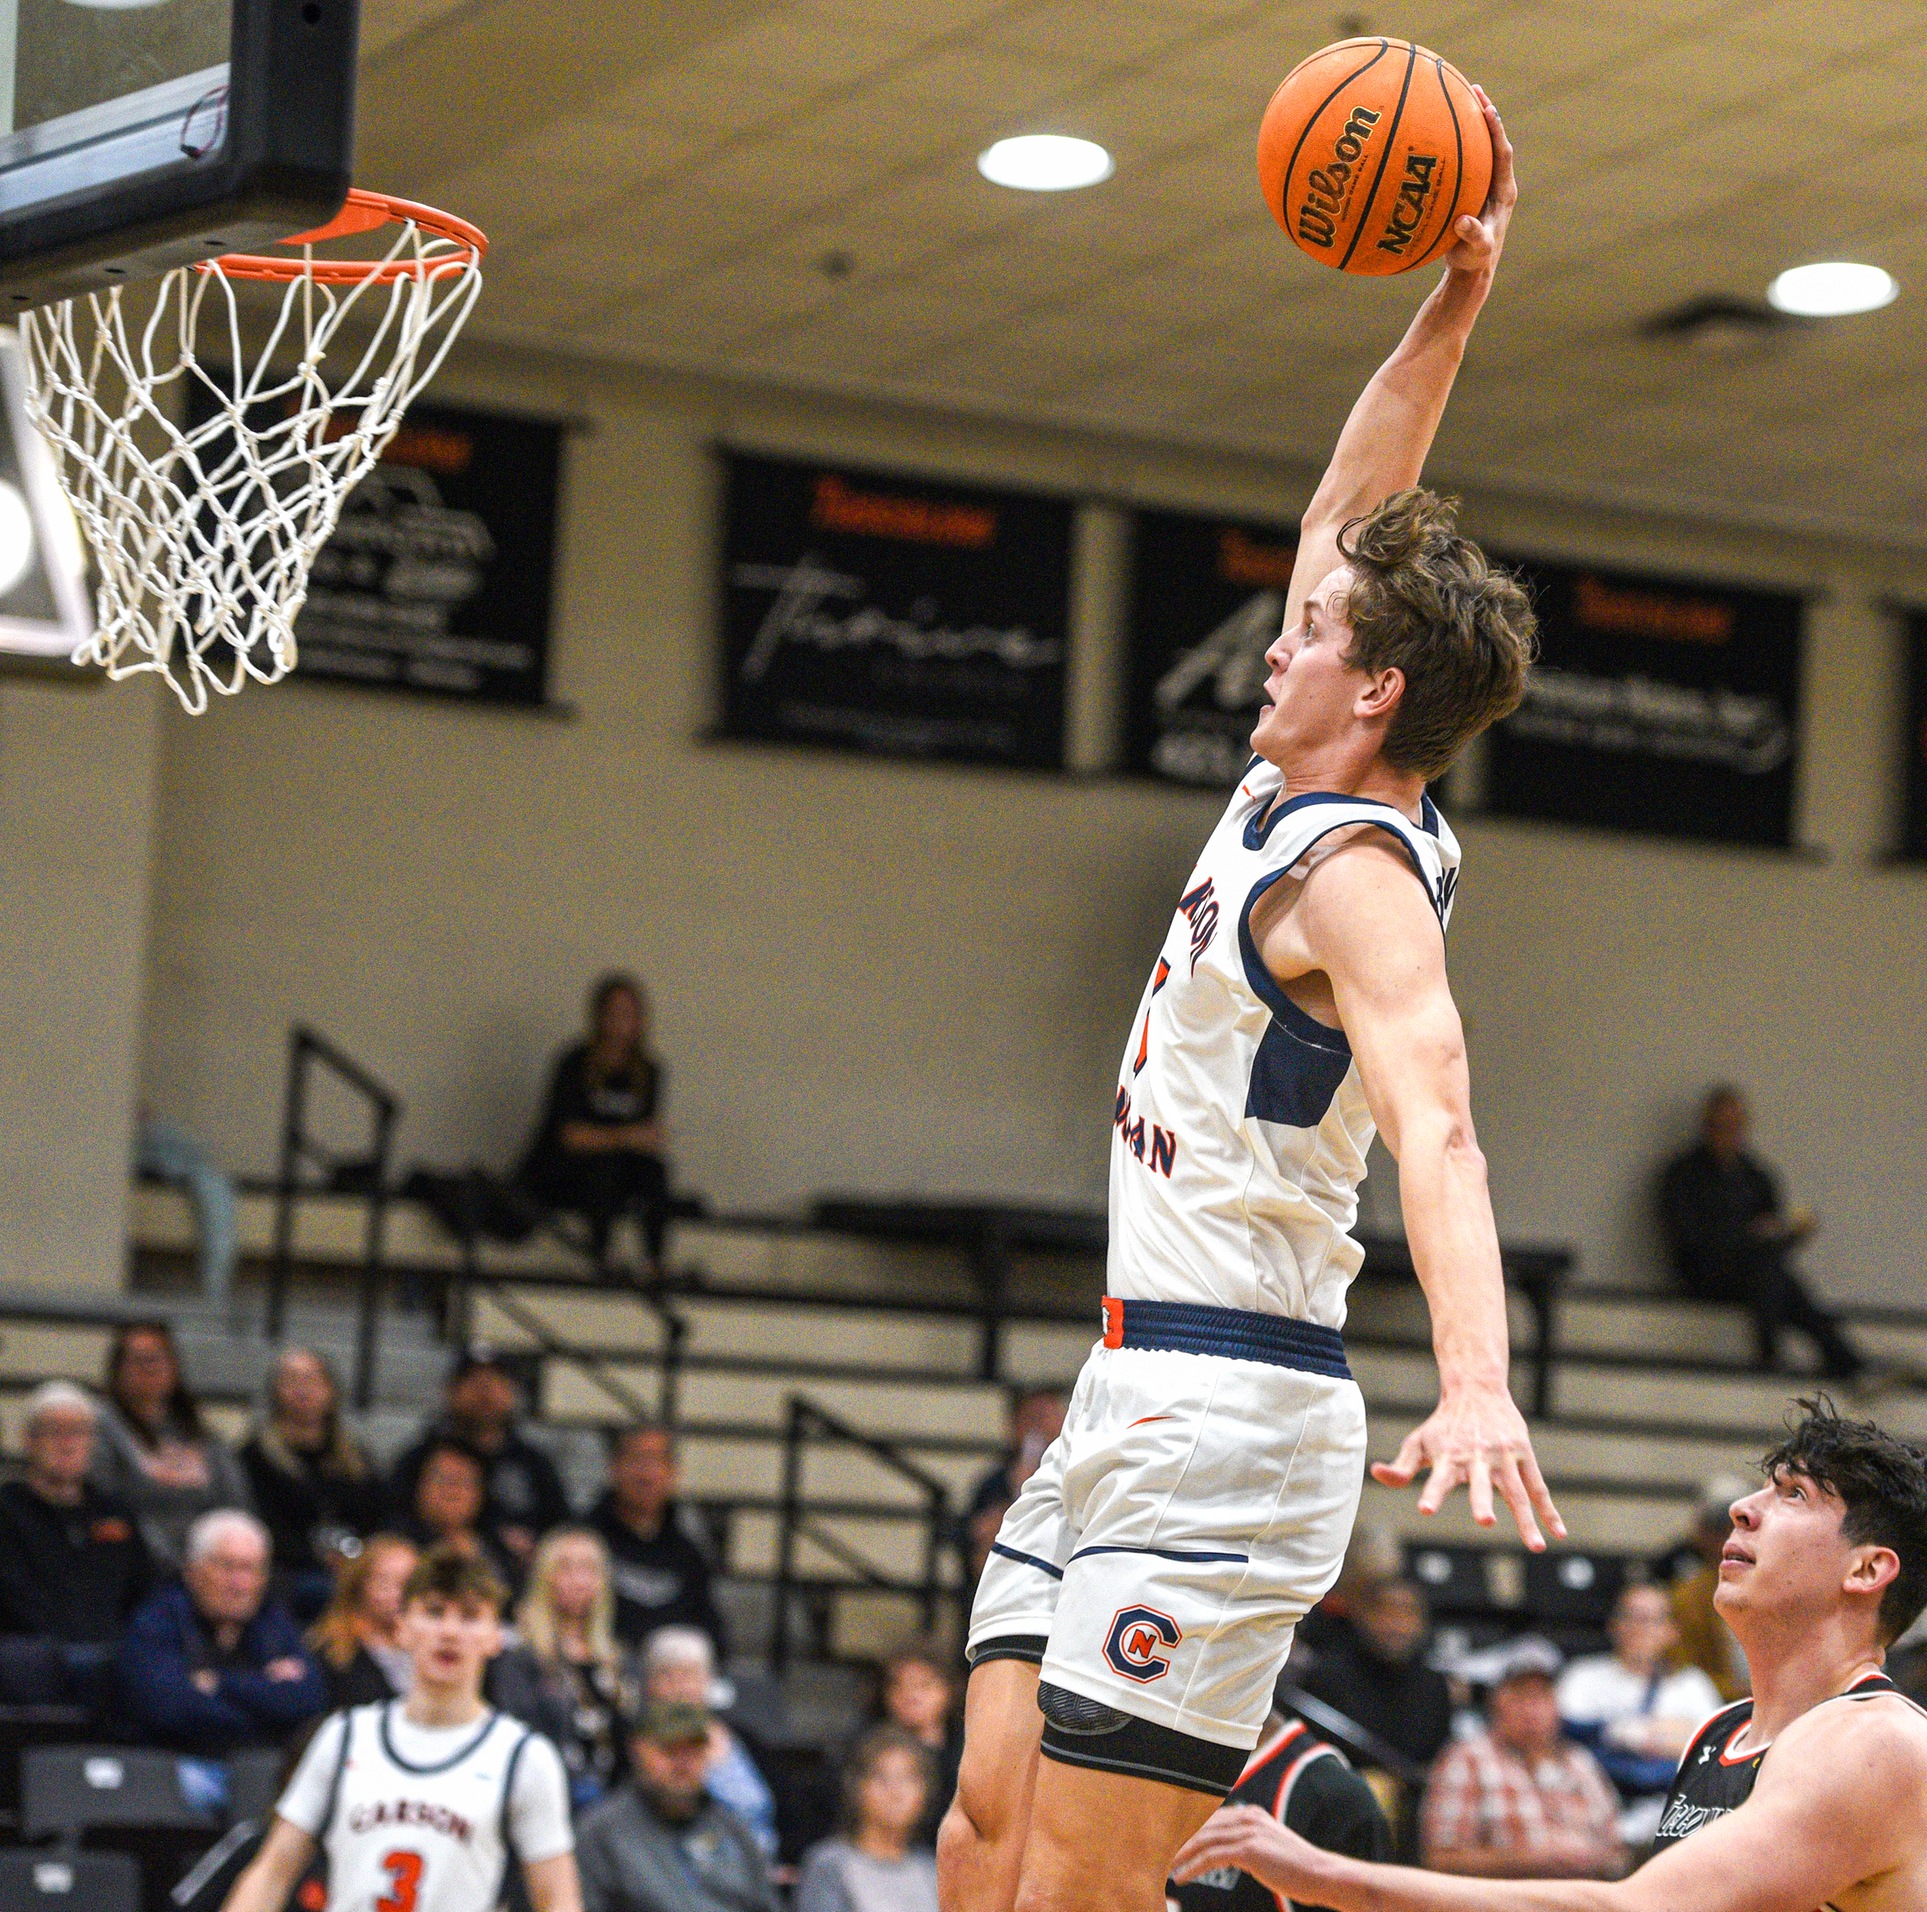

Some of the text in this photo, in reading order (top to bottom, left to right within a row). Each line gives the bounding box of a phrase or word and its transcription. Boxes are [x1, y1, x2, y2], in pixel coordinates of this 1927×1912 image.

[1299, 105, 1381, 248] Wilson
[1349, 174, 1360, 195] GAME
[1358, 155, 1368, 172] BALL
[1377, 153, 1437, 255] NCAA
[350, 1799, 474, 1844] CARSON
[375, 1850, 424, 1912] 3
